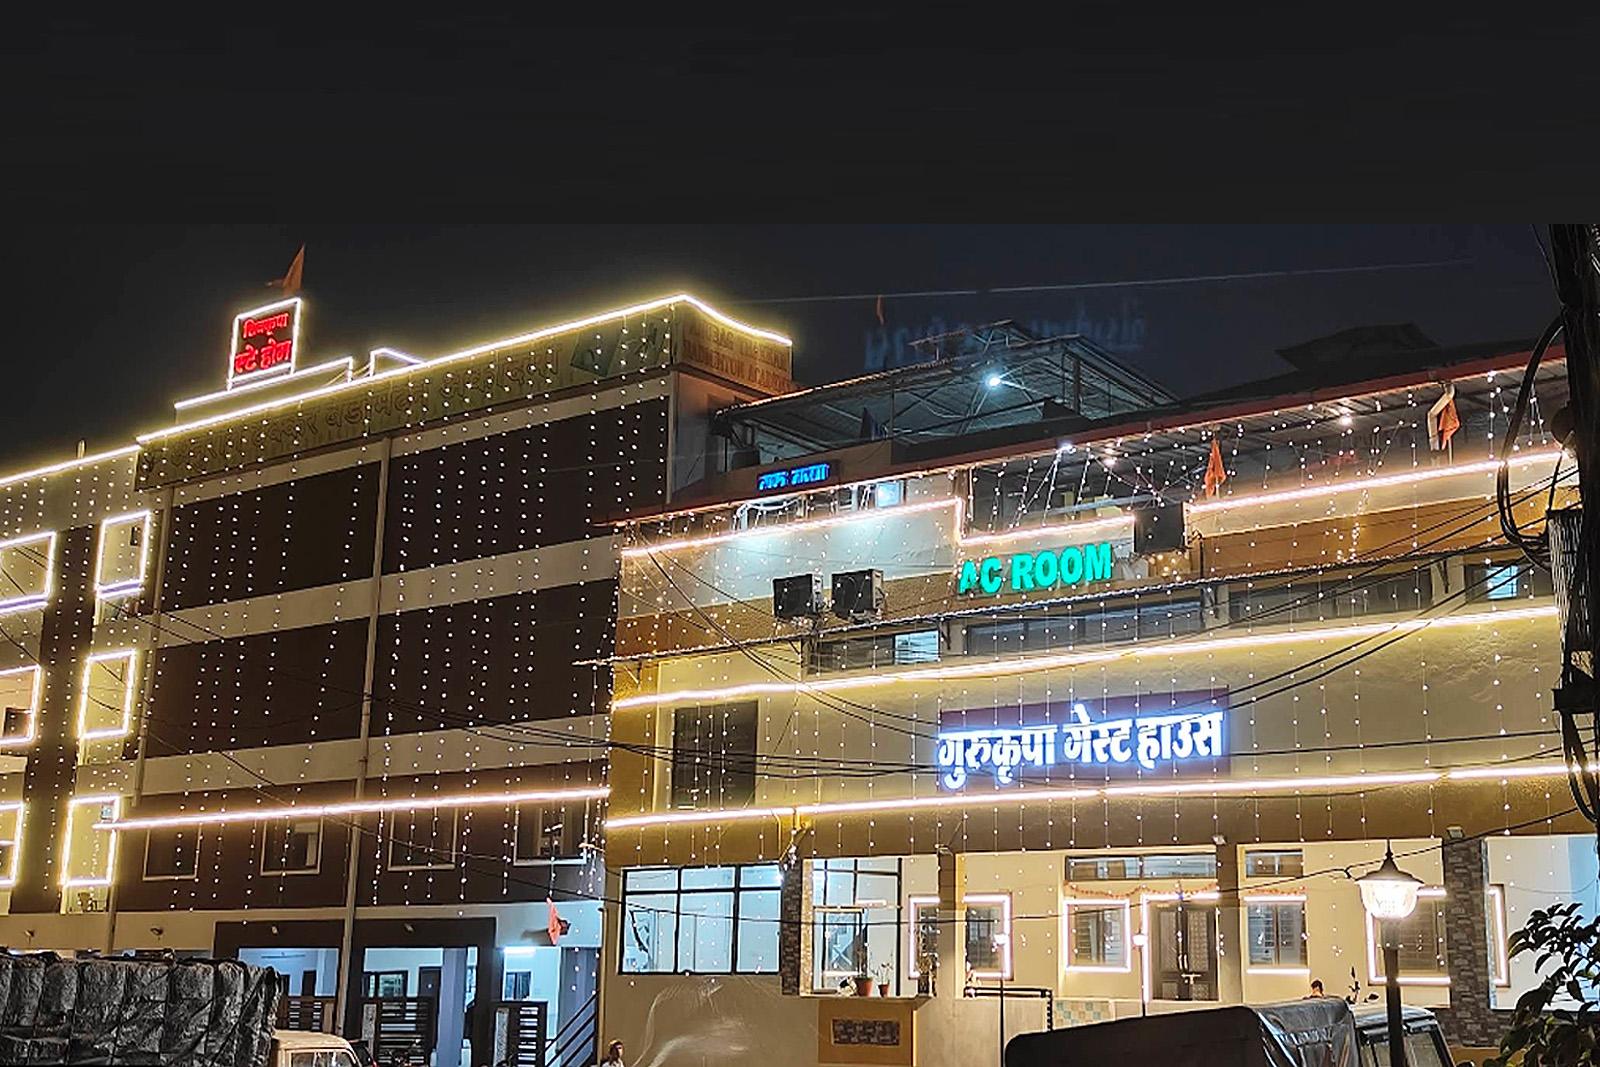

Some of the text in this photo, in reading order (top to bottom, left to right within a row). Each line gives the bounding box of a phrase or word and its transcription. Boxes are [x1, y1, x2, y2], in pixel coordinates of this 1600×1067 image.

[260, 337, 292, 369] होम
[959, 541, 1112, 595] AC ROOM
[938, 704, 1223, 789] गुरुकृपा गेस्ट हाउस
